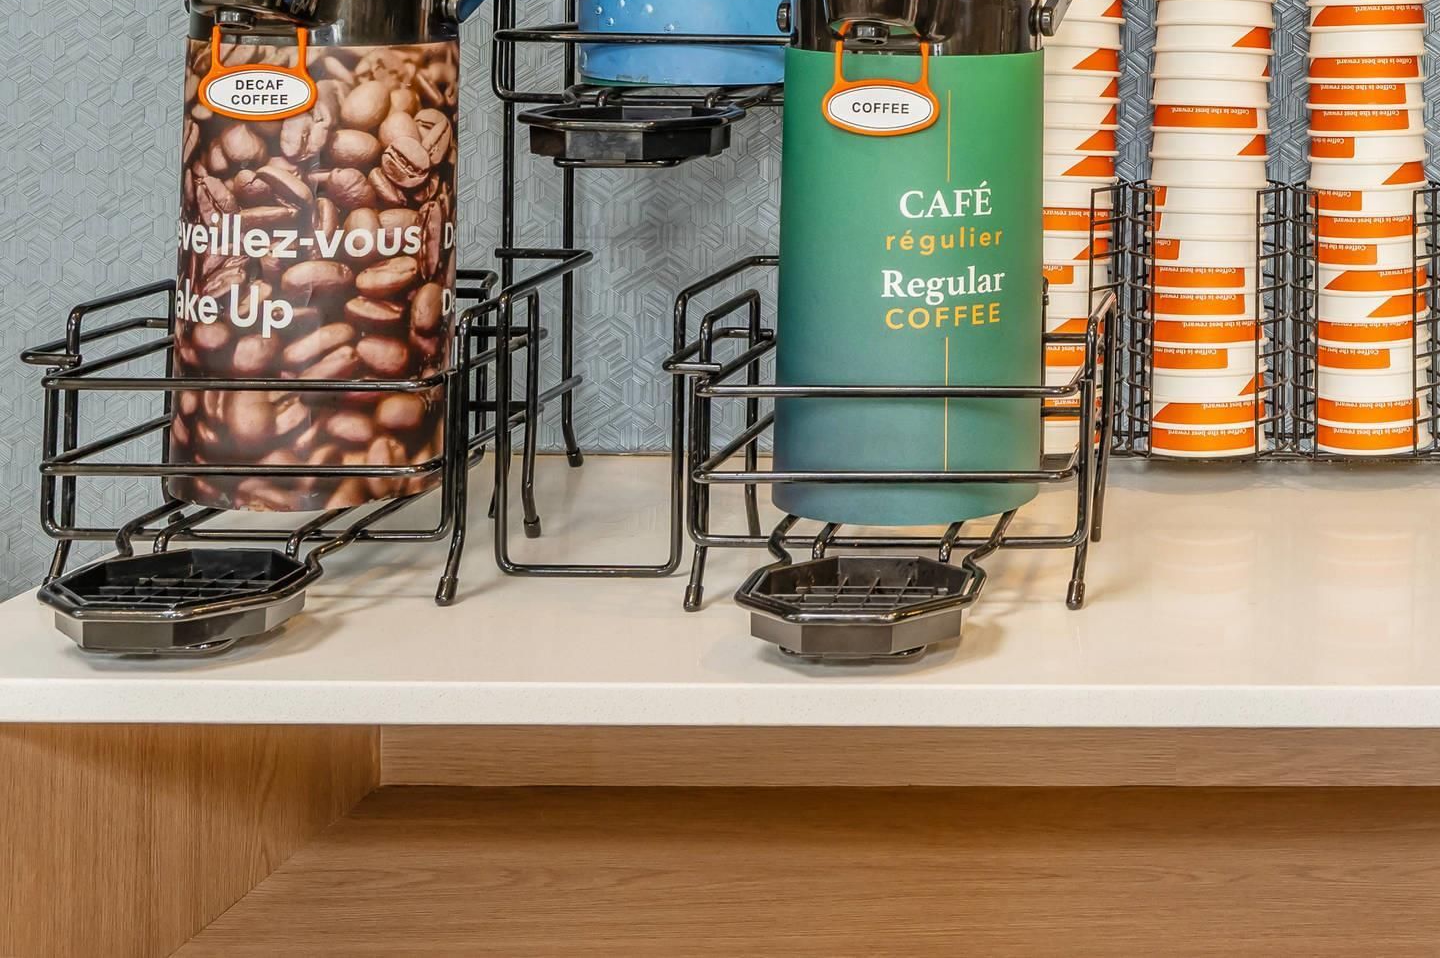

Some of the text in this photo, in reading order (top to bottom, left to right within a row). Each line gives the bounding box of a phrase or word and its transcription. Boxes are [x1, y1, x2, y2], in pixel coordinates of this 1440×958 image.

[234, 78, 285, 92] DECAF
[230, 93, 288, 106] COFFEE
[852, 102, 910, 114] COFFEE
[899, 181, 993, 219] CAFÉ
[885, 226, 1003, 256] régulier
[881, 266, 1005, 306] Regular
[176, 278, 294, 338] ake Up
[885, 303, 1001, 330] COFFEE
